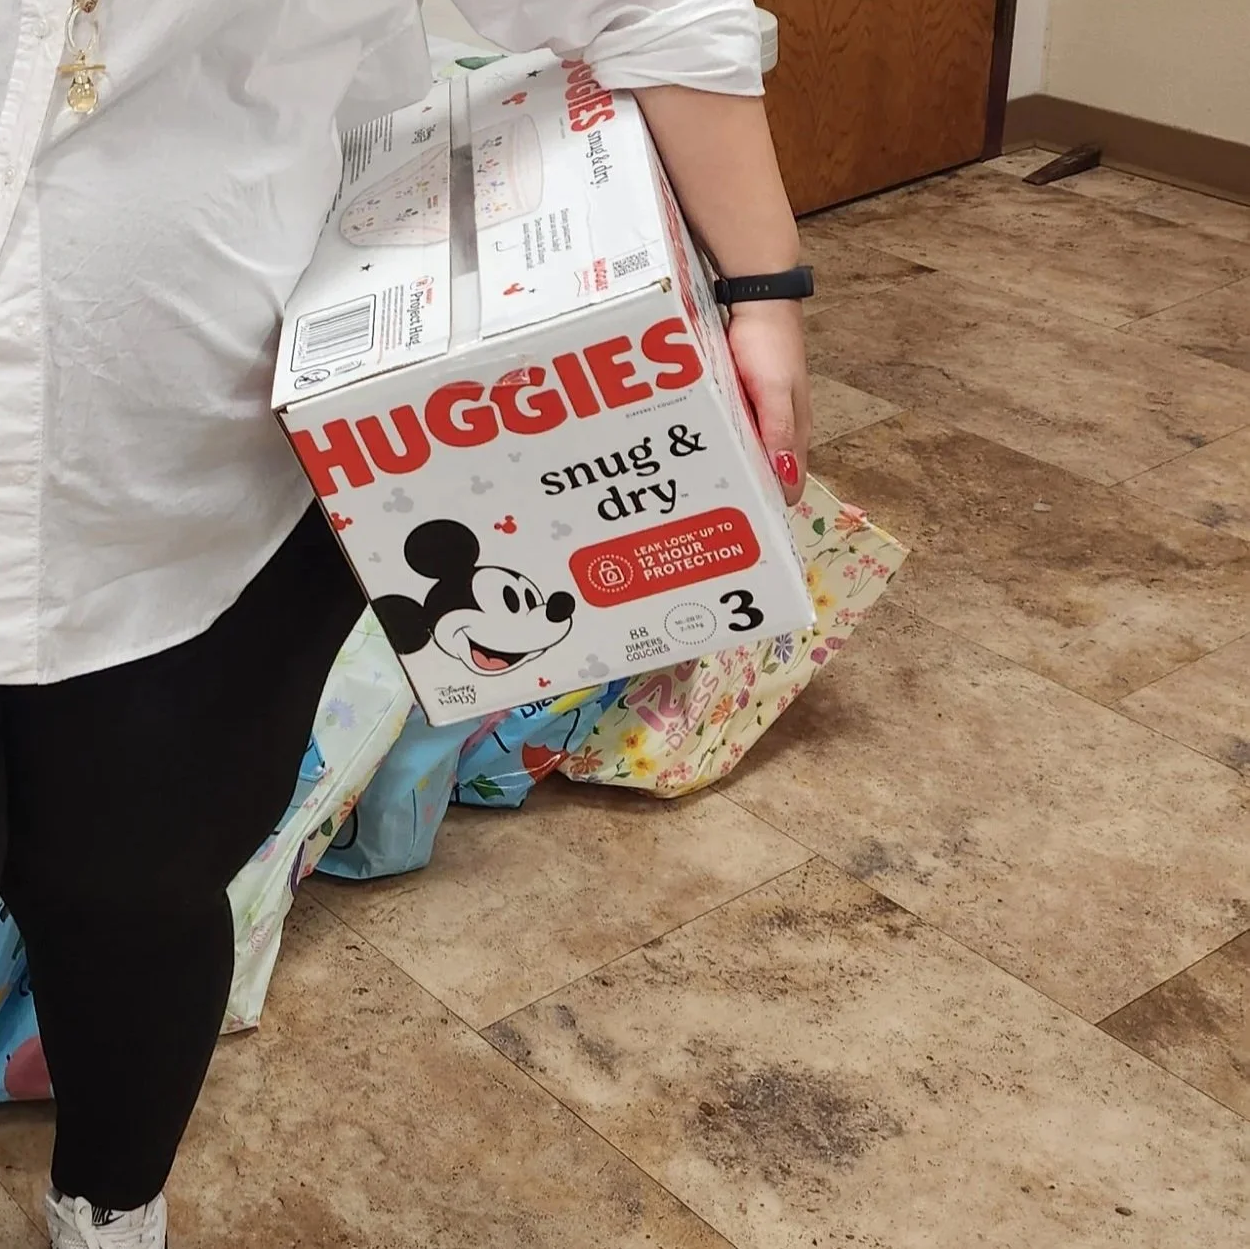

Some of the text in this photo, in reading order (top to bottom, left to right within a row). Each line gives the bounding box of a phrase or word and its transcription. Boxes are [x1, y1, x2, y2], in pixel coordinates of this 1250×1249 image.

[586, 131, 608, 158] snug
[407, 290, 424, 326] Project
[291, 316, 703, 497] HUGGIES
[540, 424, 707, 495] snug &
[634, 542, 663, 557] LEAK
[699, 527, 714, 538] UP
[717, 522, 733, 533] TO
[638, 541, 704, 569] 12 HOUR
[643, 543, 744, 581] PROTECTION
[719, 589, 764, 632] 3
[625, 637, 663, 653] DIAPERS
[629, 626, 649, 640] 88
[626, 645, 670, 662] COUCHES
